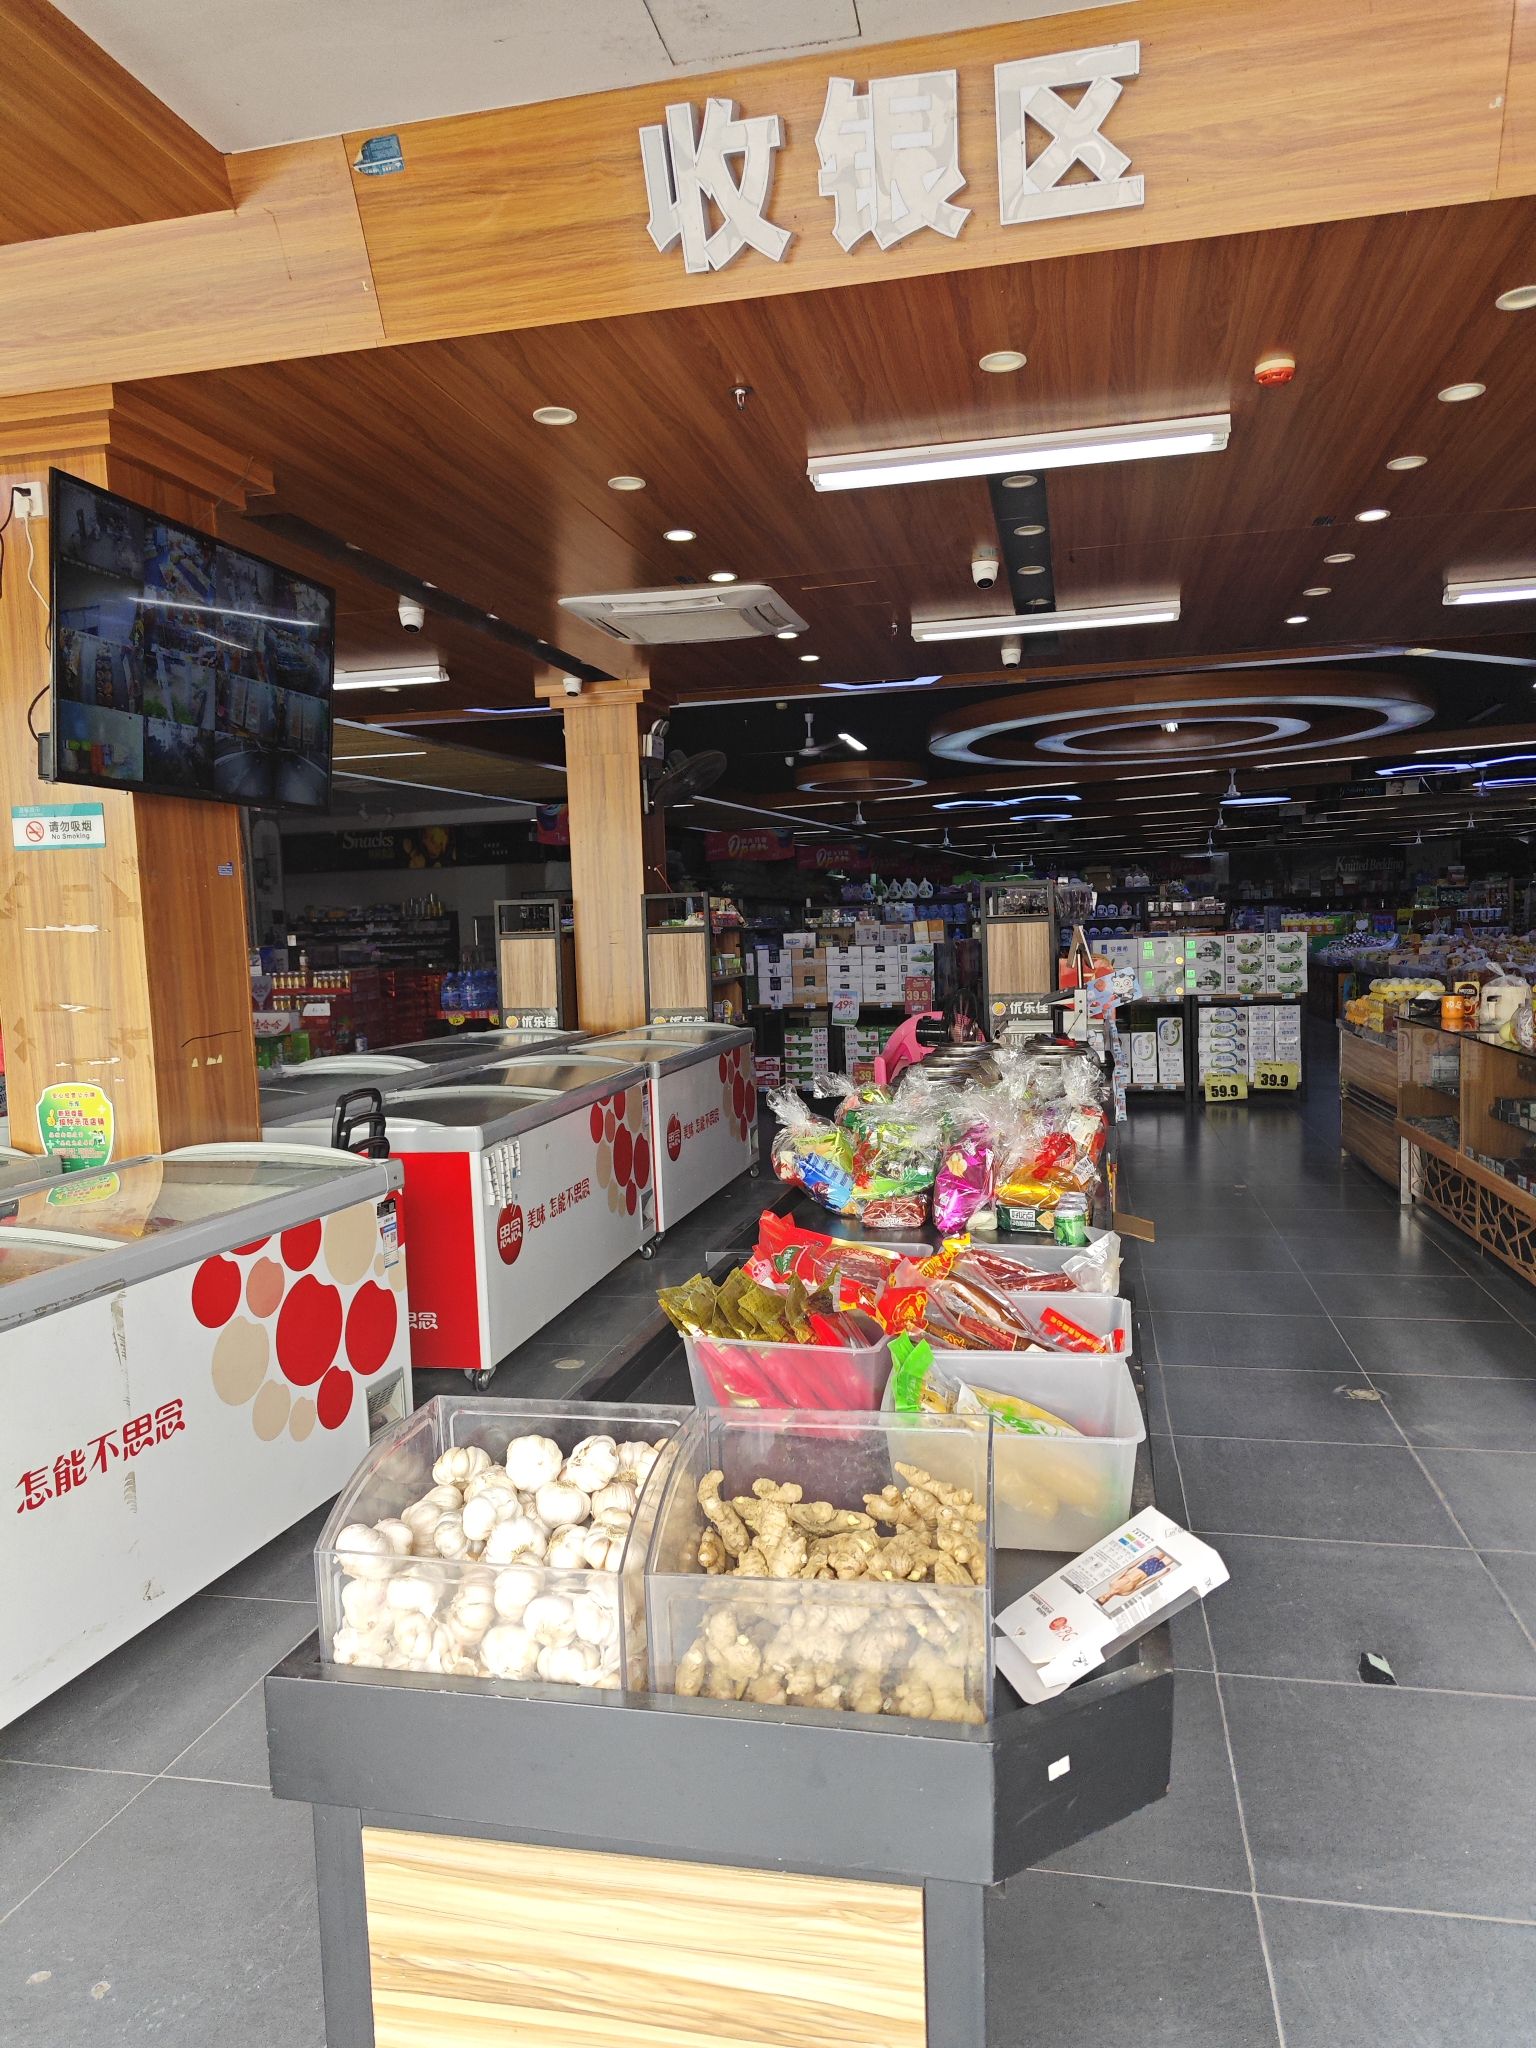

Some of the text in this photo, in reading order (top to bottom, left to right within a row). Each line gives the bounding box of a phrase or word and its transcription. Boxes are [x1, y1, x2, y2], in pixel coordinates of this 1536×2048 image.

[638, 40, 1144, 274] 收银区
[49, 820, 92, 832] 请勿吸烟
[62, 833, 90, 841] Smoking
[343, 831, 394, 850] Snacks
[1335, 855, 1369, 872] Knitted
[906, 990, 929, 1001] 39.9
[1010, 1002, 1048, 1015] 优乐佳
[522, 1015, 557, 1028] 优乐佳
[1260, 1073, 1289, 1087] 39.9
[1211, 1084, 1239, 1098] 59.9
[527, 1177, 591, 1232] 美味 怎能不思念
[499, 1217, 522, 1249] 思念
[15, 1398, 186, 1514] 怎能不思念
